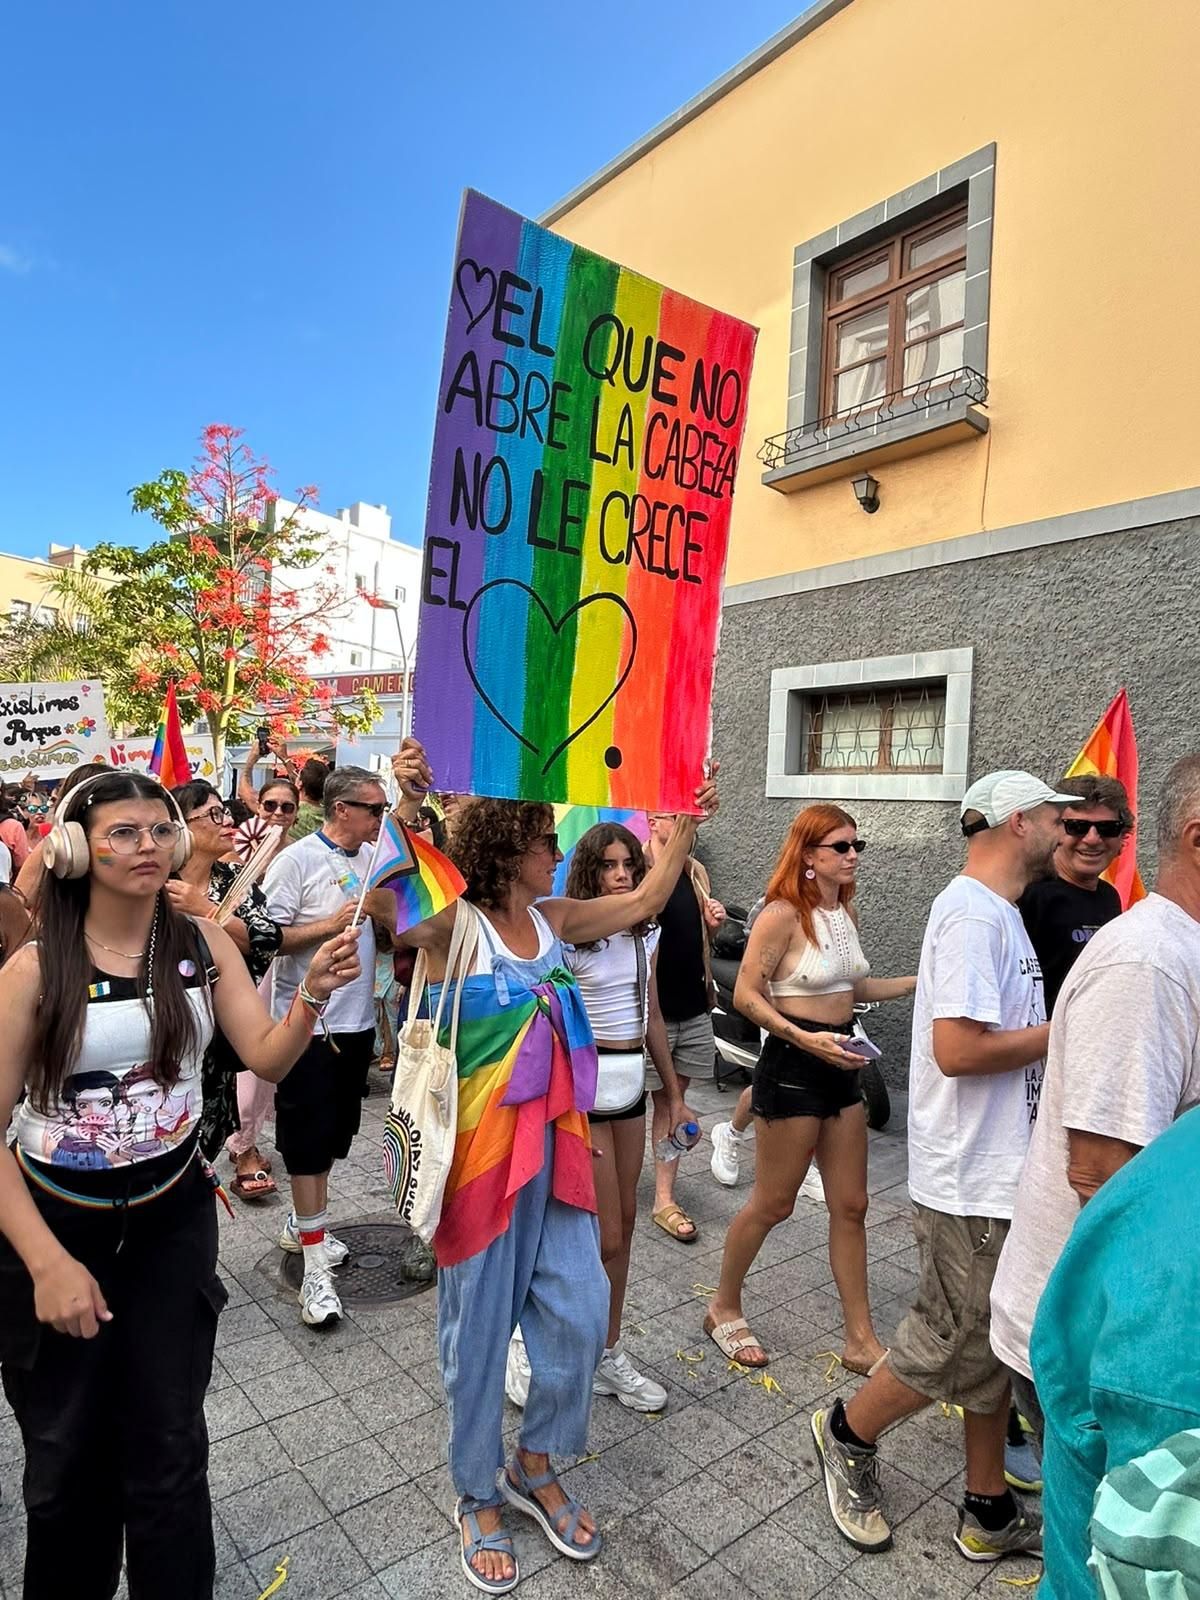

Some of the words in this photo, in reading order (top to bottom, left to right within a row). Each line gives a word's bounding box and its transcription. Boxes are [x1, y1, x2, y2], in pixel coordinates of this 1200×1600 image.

[492, 270, 555, 358] EL
[582, 313, 686, 408] QUE
[690, 357, 742, 428] NO
[445, 350, 573, 451] ABRE
[589, 395, 635, 472] LA
[643, 411, 738, 499] CABEZA
[450, 447, 512, 535] NO
[527, 469, 591, 556] LE
[599, 490, 710, 585] CRECE
[422, 535, 468, 611] EL
[4, 719, 62, 746] Porque
[398, 1106, 416, 1128] HAY
